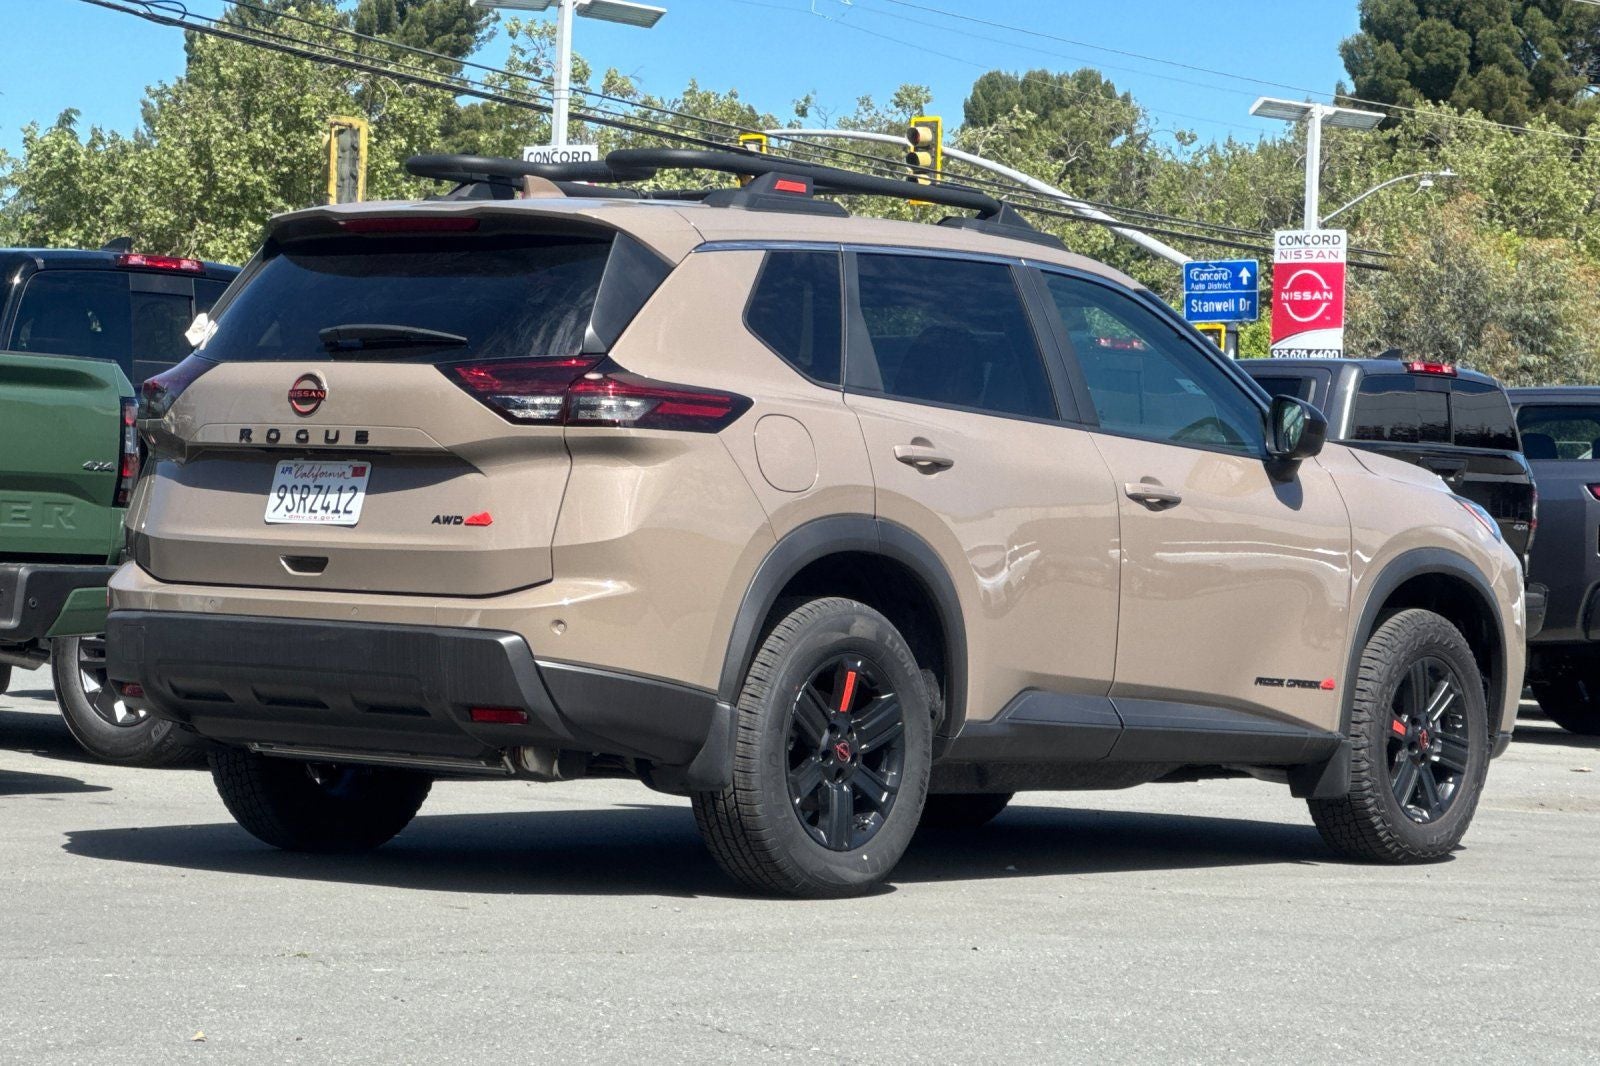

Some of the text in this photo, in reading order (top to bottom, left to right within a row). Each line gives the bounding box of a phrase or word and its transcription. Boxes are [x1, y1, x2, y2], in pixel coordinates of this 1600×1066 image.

[528, 151, 592, 163] CONCORD
[1278, 234, 1341, 246] CONCORD
[1279, 250, 1339, 260] NISSAN
[1193, 270, 1228, 281] Concord
[1190, 281, 1232, 290] Auto District
[1281, 291, 1333, 300] NISSAN
[1191, 297, 1252, 313] Stanwell Dr
[289, 390, 326, 399] NISSAN
[239, 428, 369, 445] ROGUE
[280, 466, 293, 475] APR
[294, 463, 353, 483] California
[272, 484, 359, 514] 9SRZ412
[431, 514, 464, 525] AWD
